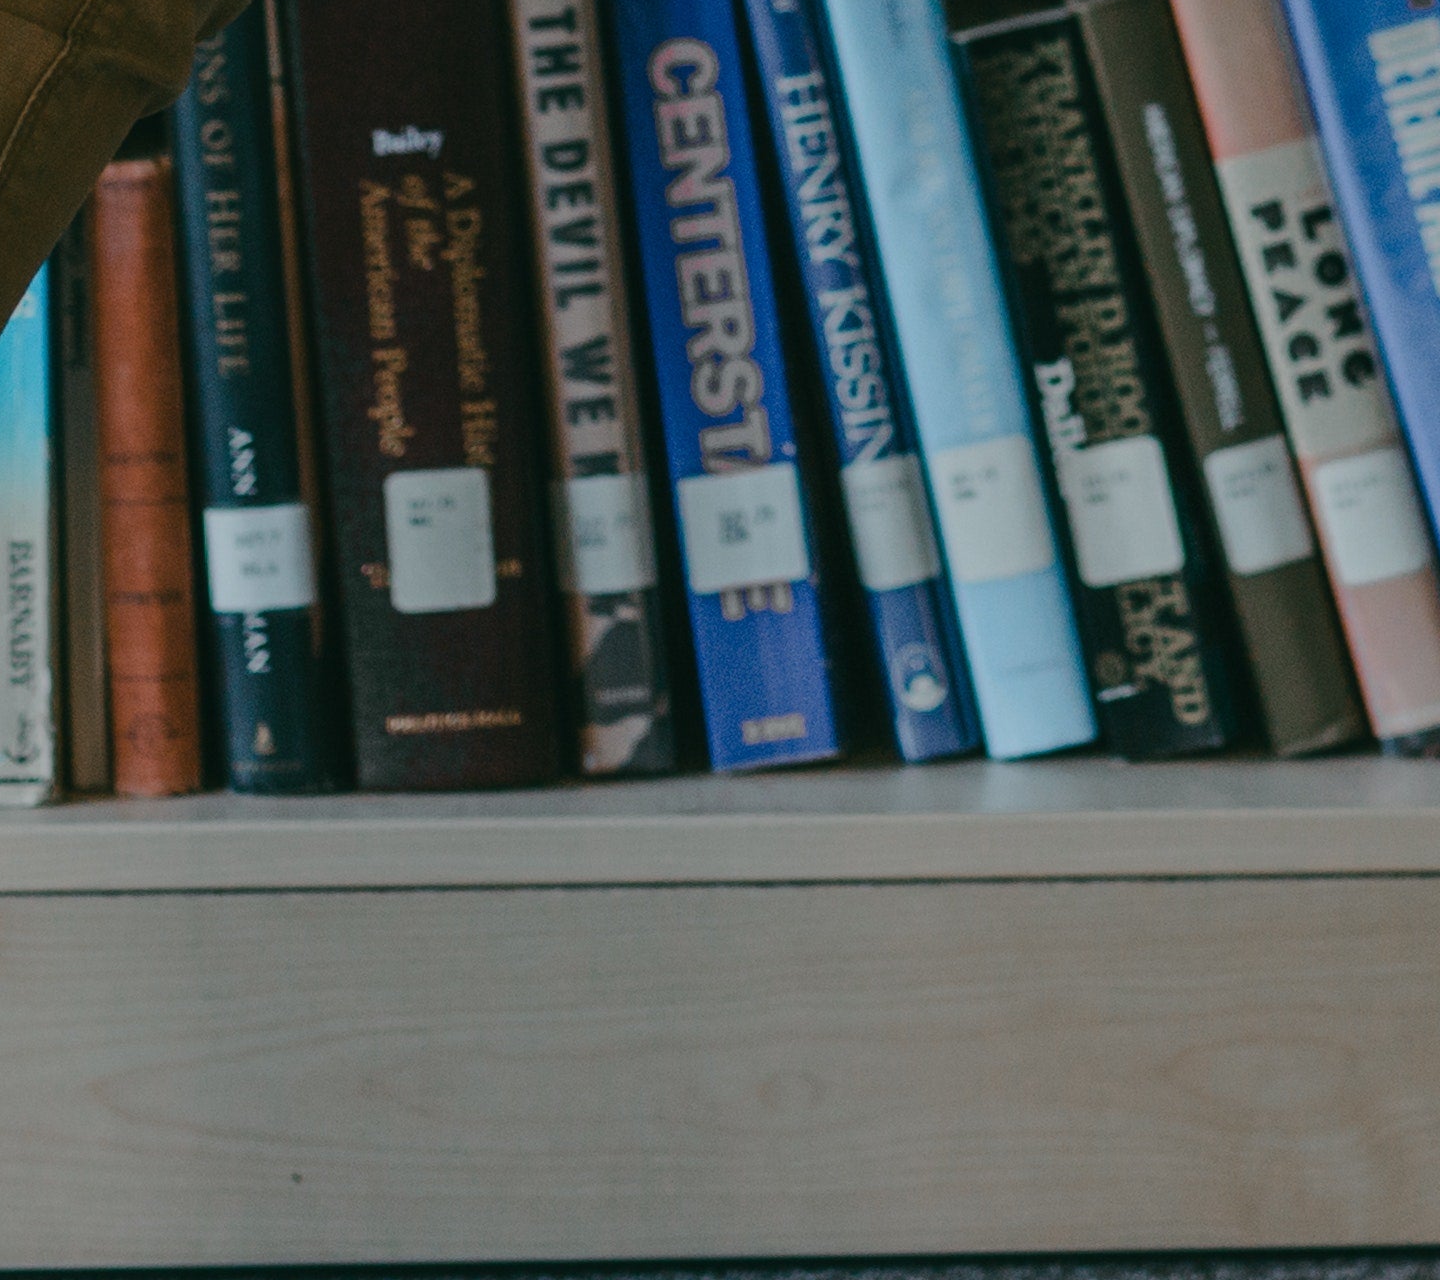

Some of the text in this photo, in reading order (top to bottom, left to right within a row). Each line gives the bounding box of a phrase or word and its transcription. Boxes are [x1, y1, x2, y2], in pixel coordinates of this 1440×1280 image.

[398, 175, 440, 270] of the
[524, 7, 618, 428] THE DEVIL WE
[771, 71, 853, 269] HENRY
[1028, 38, 1124, 291] FRANKLIN
[358, 178, 414, 457] American People
[440, 209, 485, 390] Diplomatic
[1243, 197, 1333, 409] PEACE
[1294, 203, 1378, 393] LONG
[225, 425, 256, 496] ANN
[5, 538, 36, 690] BARNABY
